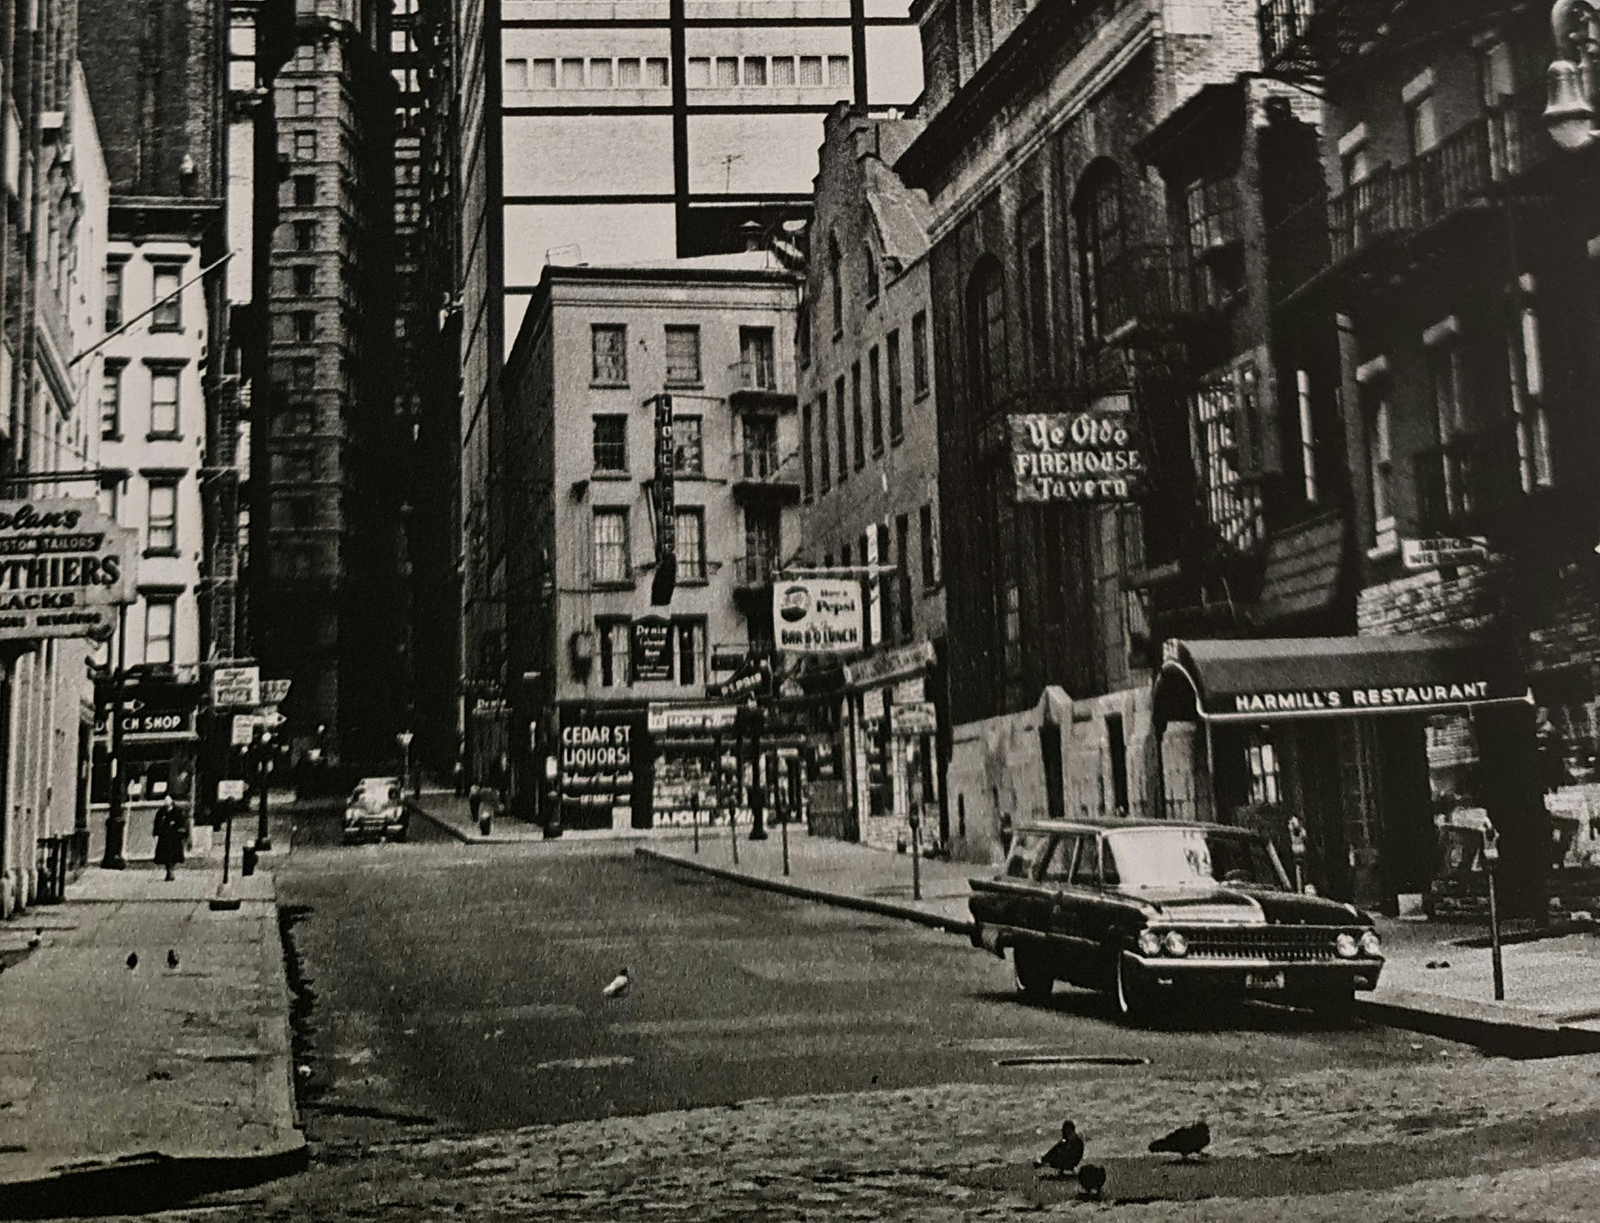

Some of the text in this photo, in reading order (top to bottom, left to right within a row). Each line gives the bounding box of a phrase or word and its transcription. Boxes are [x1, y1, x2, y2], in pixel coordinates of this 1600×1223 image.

[1024, 414, 1129, 451] Ye Olde
[1016, 450, 1141, 475] FIREHOUSE
[1037, 477, 1128, 501] Tavern
[0, 537, 96, 552] STOM TAILORS
[0, 554, 121, 590] THIERS
[816, 599, 856, 616] Pepsi
[1235, 681, 1488, 713] HARMILL'S RESTAURANT
[145, 715, 182, 731] SHOP
[562, 725, 631, 745] CEDAR ST
[563, 747, 627, 767] LIQUORS
